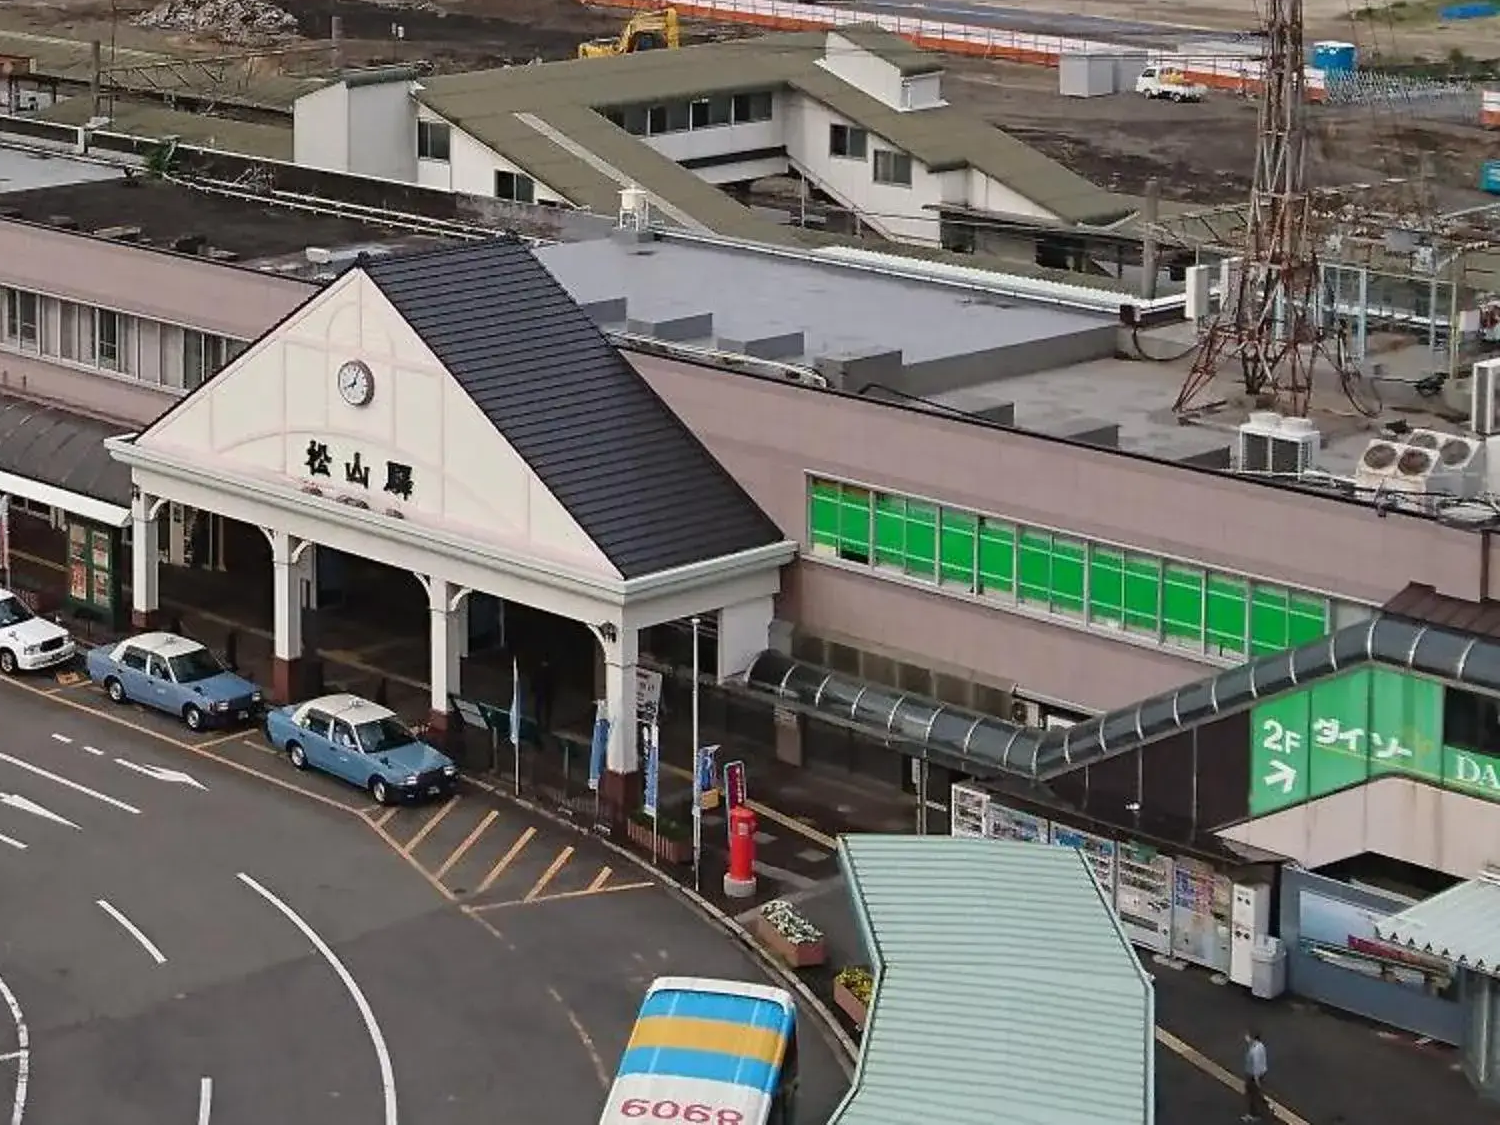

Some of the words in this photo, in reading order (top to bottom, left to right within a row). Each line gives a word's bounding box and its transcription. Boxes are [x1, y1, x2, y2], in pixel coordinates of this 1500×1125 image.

[1264, 719, 1301, 754] 2F
[1313, 718, 1412, 759] ダイソー
[621, 1098, 744, 1125] 6068
